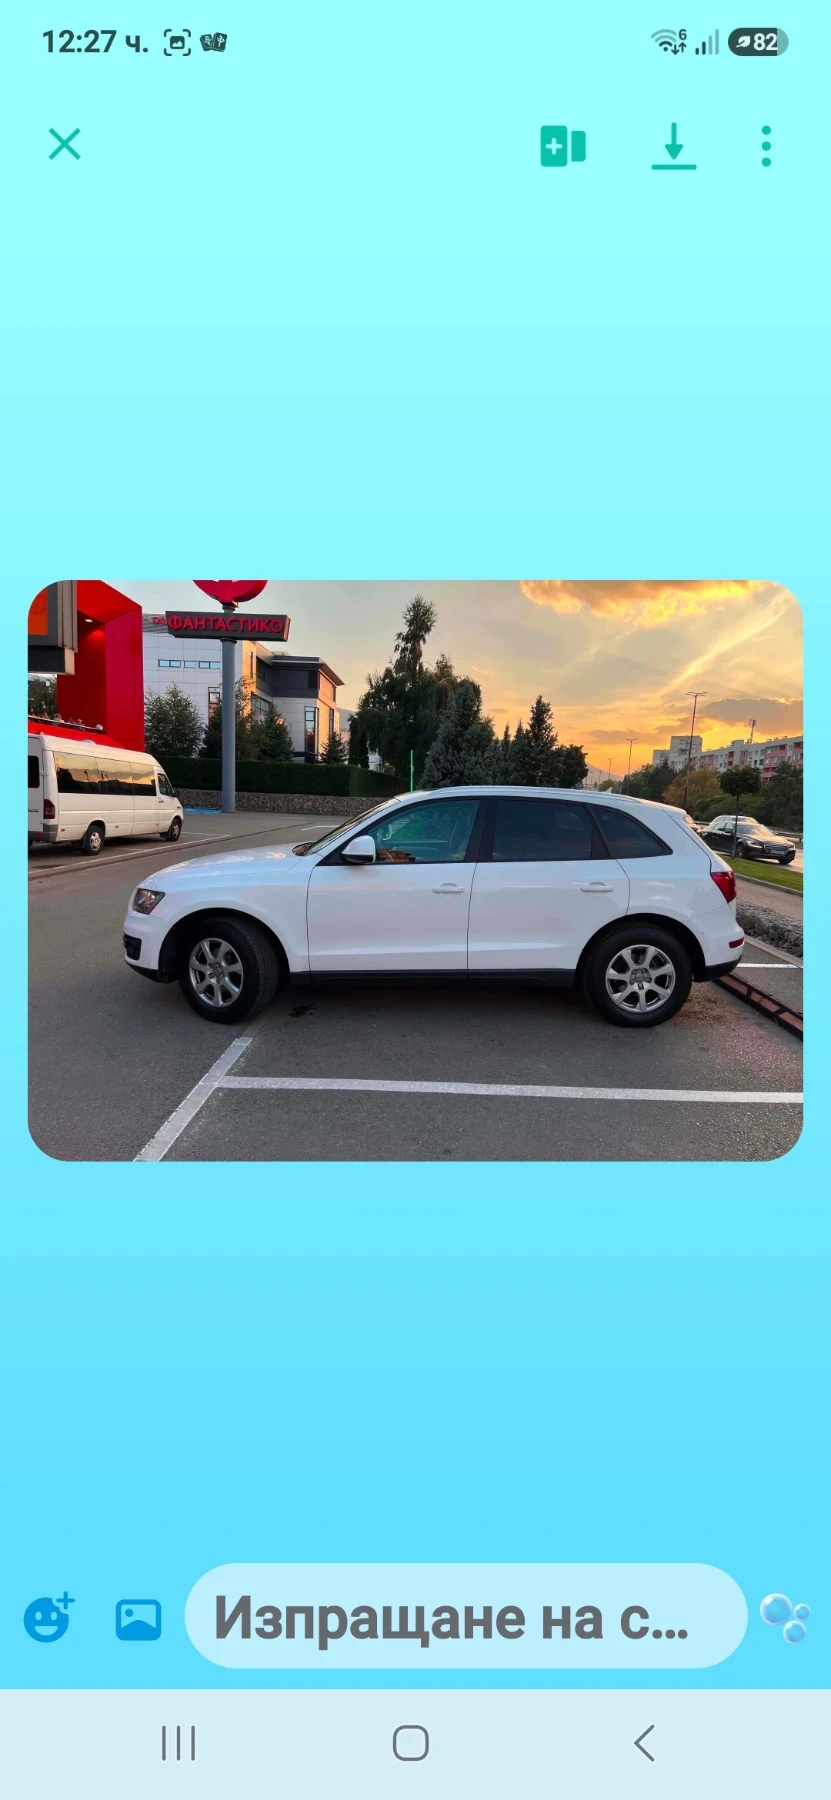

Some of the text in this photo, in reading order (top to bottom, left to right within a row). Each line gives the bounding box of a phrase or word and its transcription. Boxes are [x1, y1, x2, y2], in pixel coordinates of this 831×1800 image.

[42, 29, 117, 53] 12:27
[753, 32, 778, 51] 82
[168, 614, 283, 633] ФАНТАСТИКО
[215, 1595, 526, 1651] Изпращане
[542, 1605, 604, 1640] на
